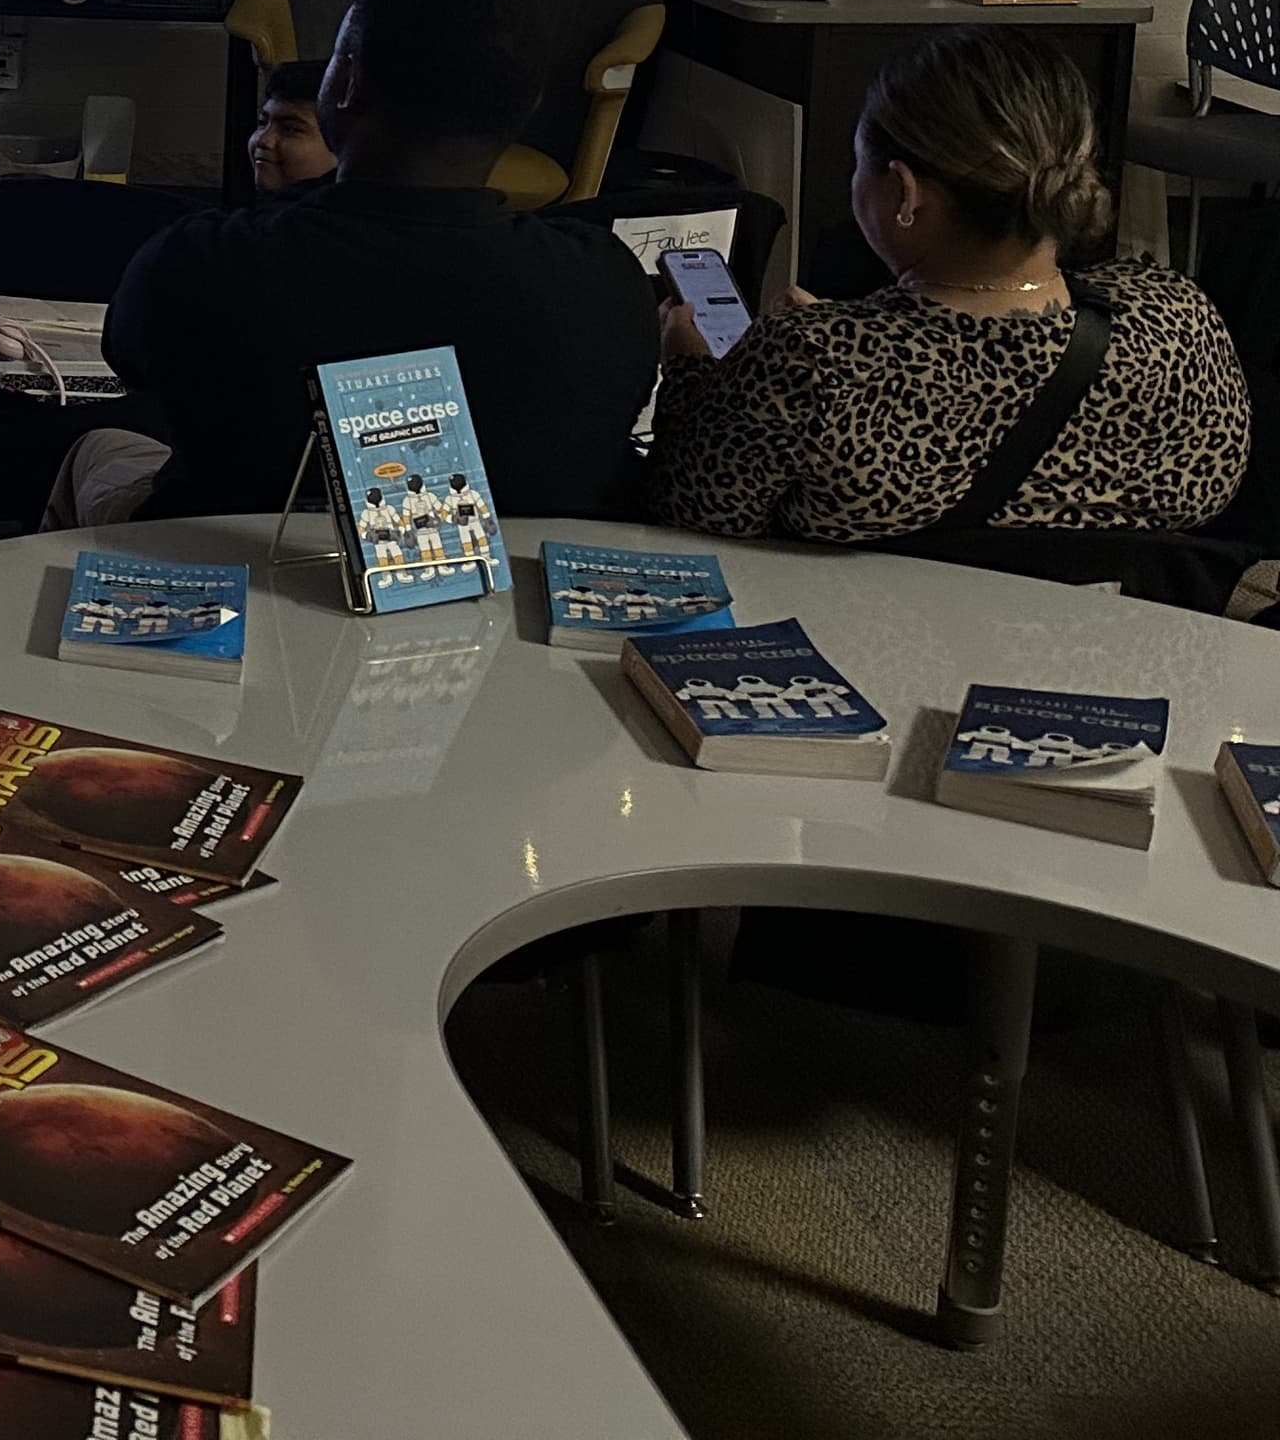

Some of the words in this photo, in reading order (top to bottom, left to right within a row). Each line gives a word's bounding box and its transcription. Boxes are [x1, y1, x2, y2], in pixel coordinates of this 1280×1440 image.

[336, 375, 393, 392] STUART
[398, 366, 442, 383] GIBBS
[338, 409, 405, 438] space
[407, 400, 460, 421] case
[363, 434, 378, 445] THE
[83, 568, 167, 586] space
[170, 577, 237, 590] case
[553, 558, 637, 575] space
[642, 564, 711, 581] case
[653, 648, 739, 664] space
[742, 647, 815, 660] case
[973, 699, 1074, 721] space
[1079, 715, 1162, 734] case
[9, 923, 105, 973] Amazing
[11, 985, 29, 998] of
[26, 974, 49, 990] the
[43, 951, 87, 979] Red
[119, 1223, 151, 1248] The
[135, 1161, 229, 1232] Amazing
[153, 1242, 172, 1261] of
[164, 1229, 192, 1251] the
[182, 1202, 223, 1243] Red
